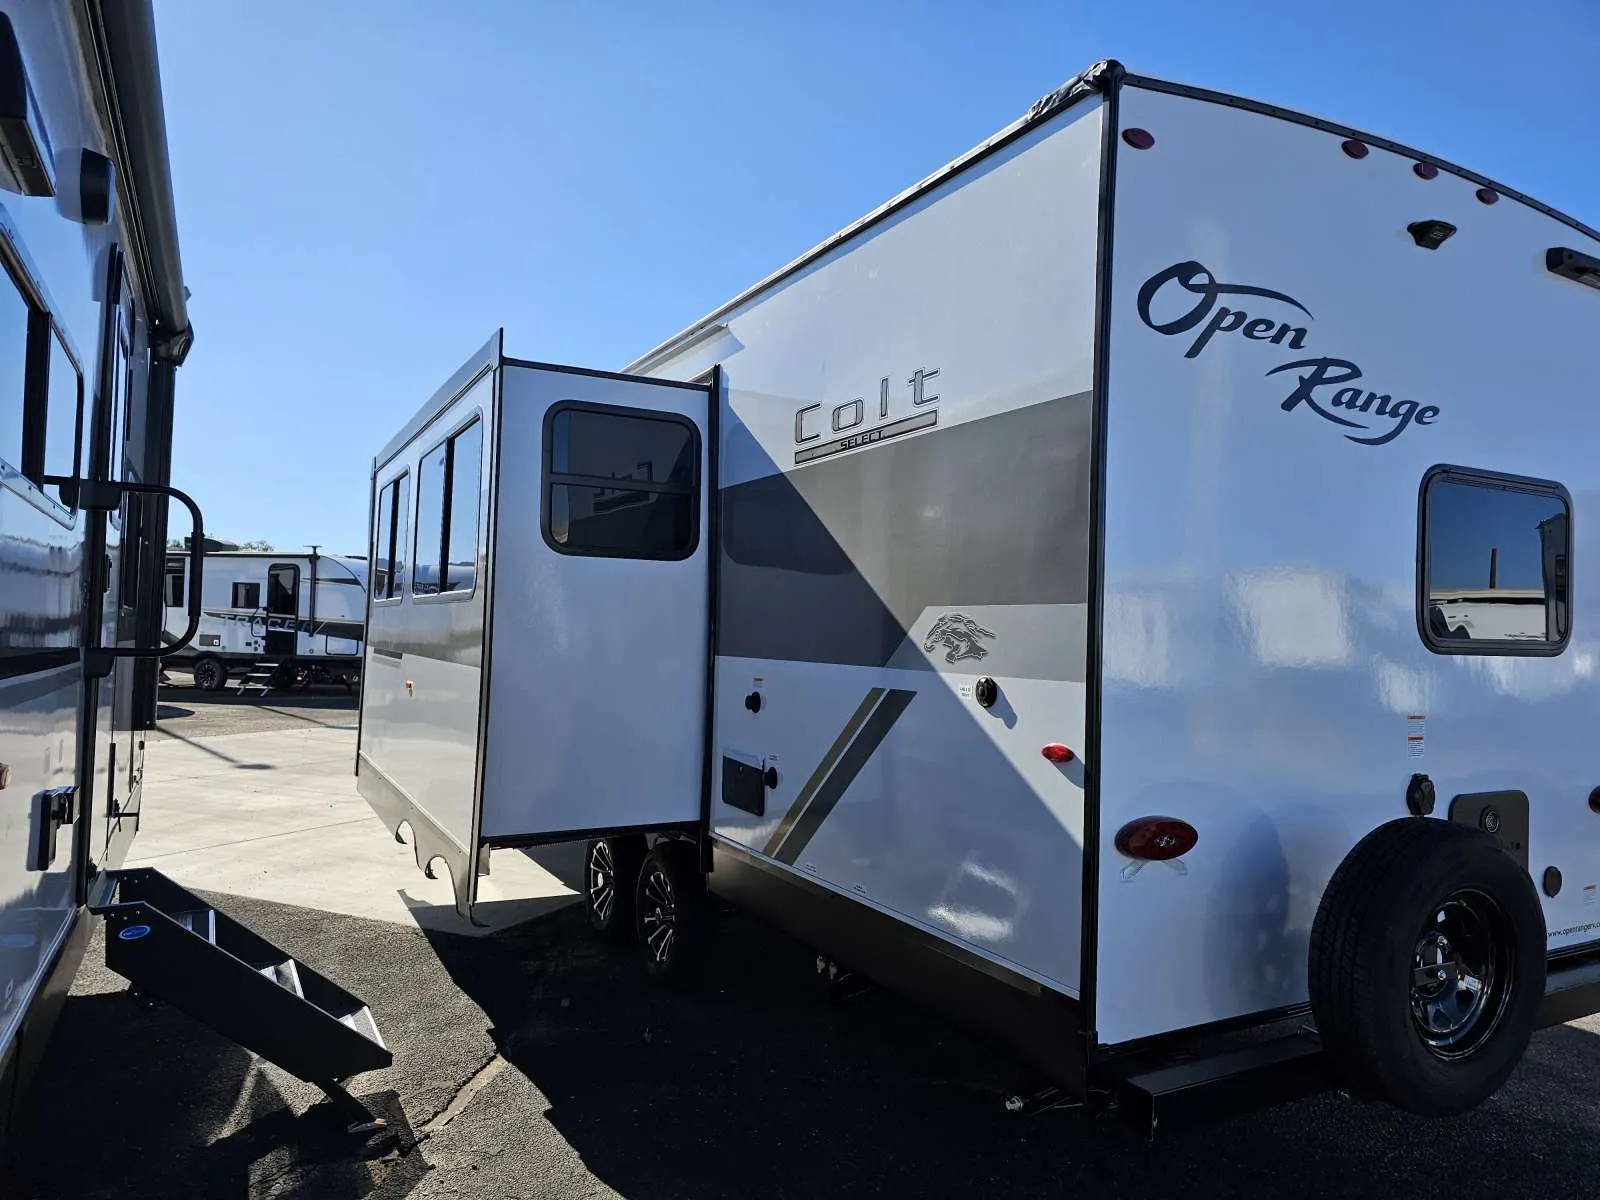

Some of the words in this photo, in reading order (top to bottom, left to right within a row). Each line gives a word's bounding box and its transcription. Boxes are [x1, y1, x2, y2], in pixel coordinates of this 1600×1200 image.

[1137, 260, 1314, 359] Open
[840, 430, 884, 451] SELECT
[1265, 357, 1440, 446] Range
